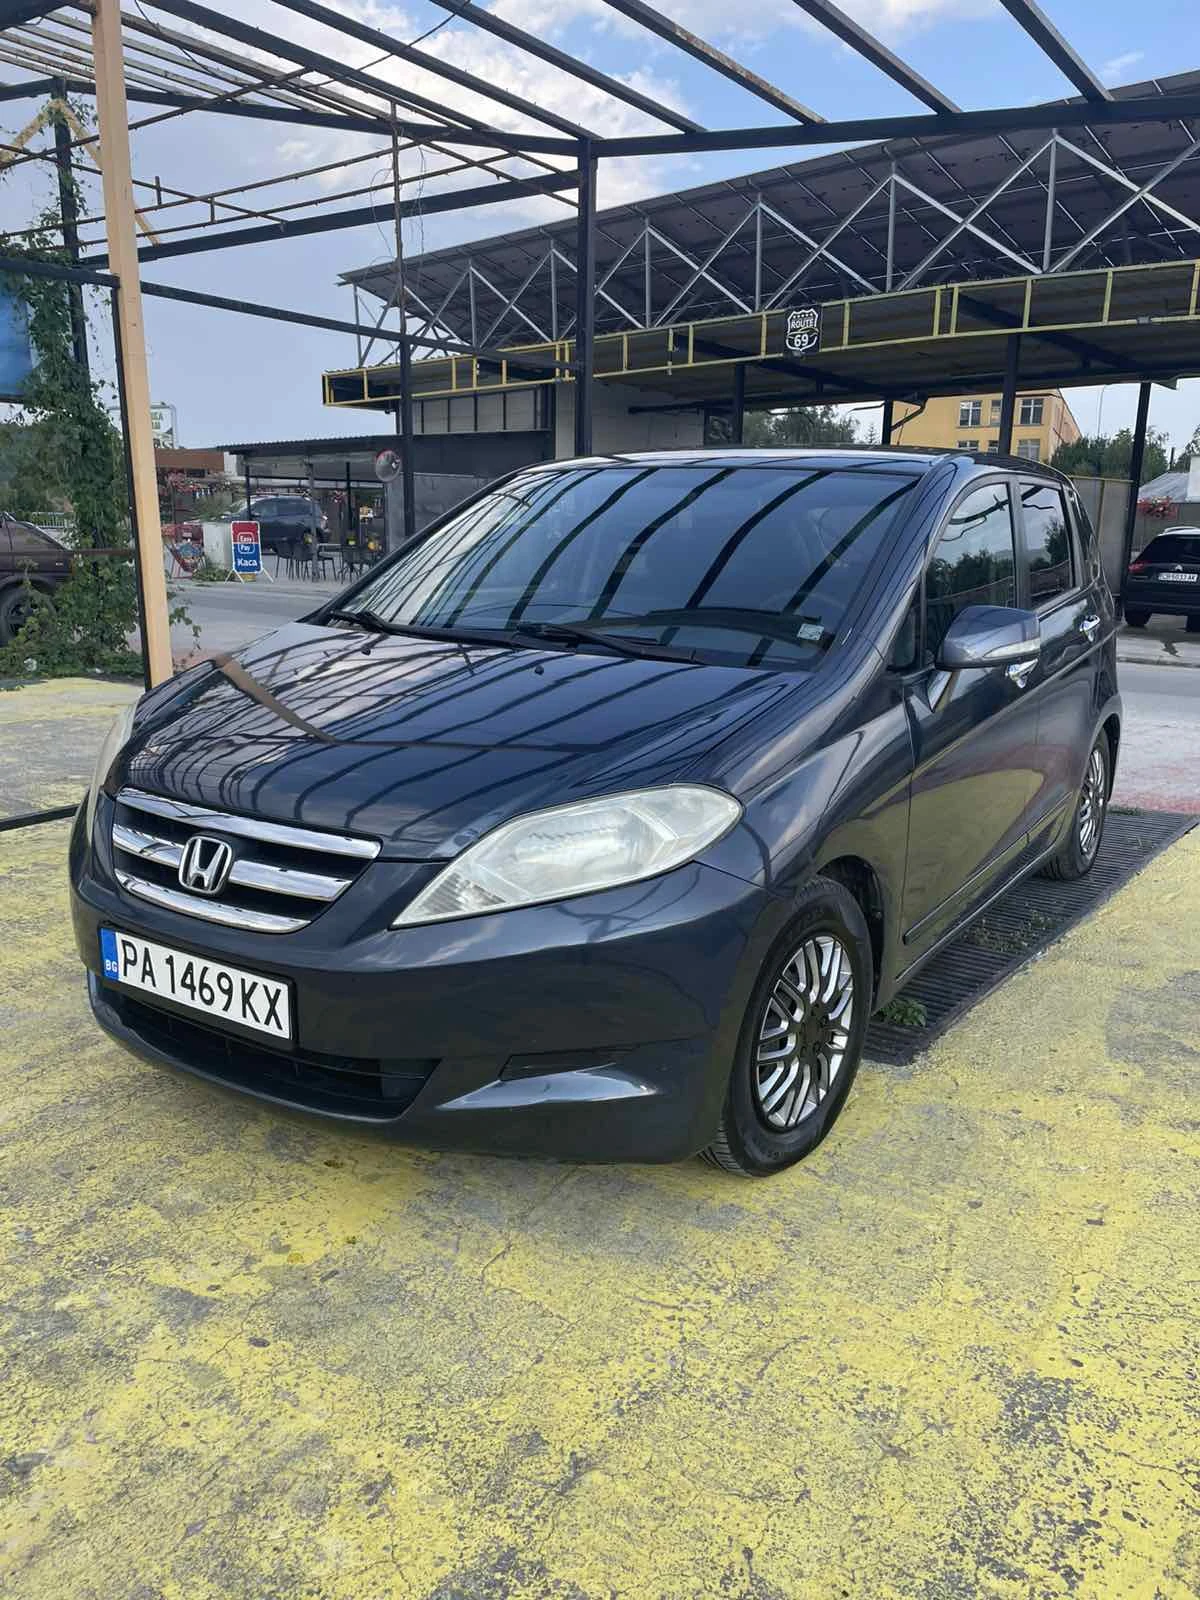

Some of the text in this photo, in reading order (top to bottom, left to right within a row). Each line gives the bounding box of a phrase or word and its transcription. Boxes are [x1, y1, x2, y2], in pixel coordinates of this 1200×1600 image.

[790, 318, 814, 329] ROUTE
[794, 334, 809, 347] 69
[105, 959, 118, 973] BG
[121, 939, 283, 1031] PA 1469 KX
